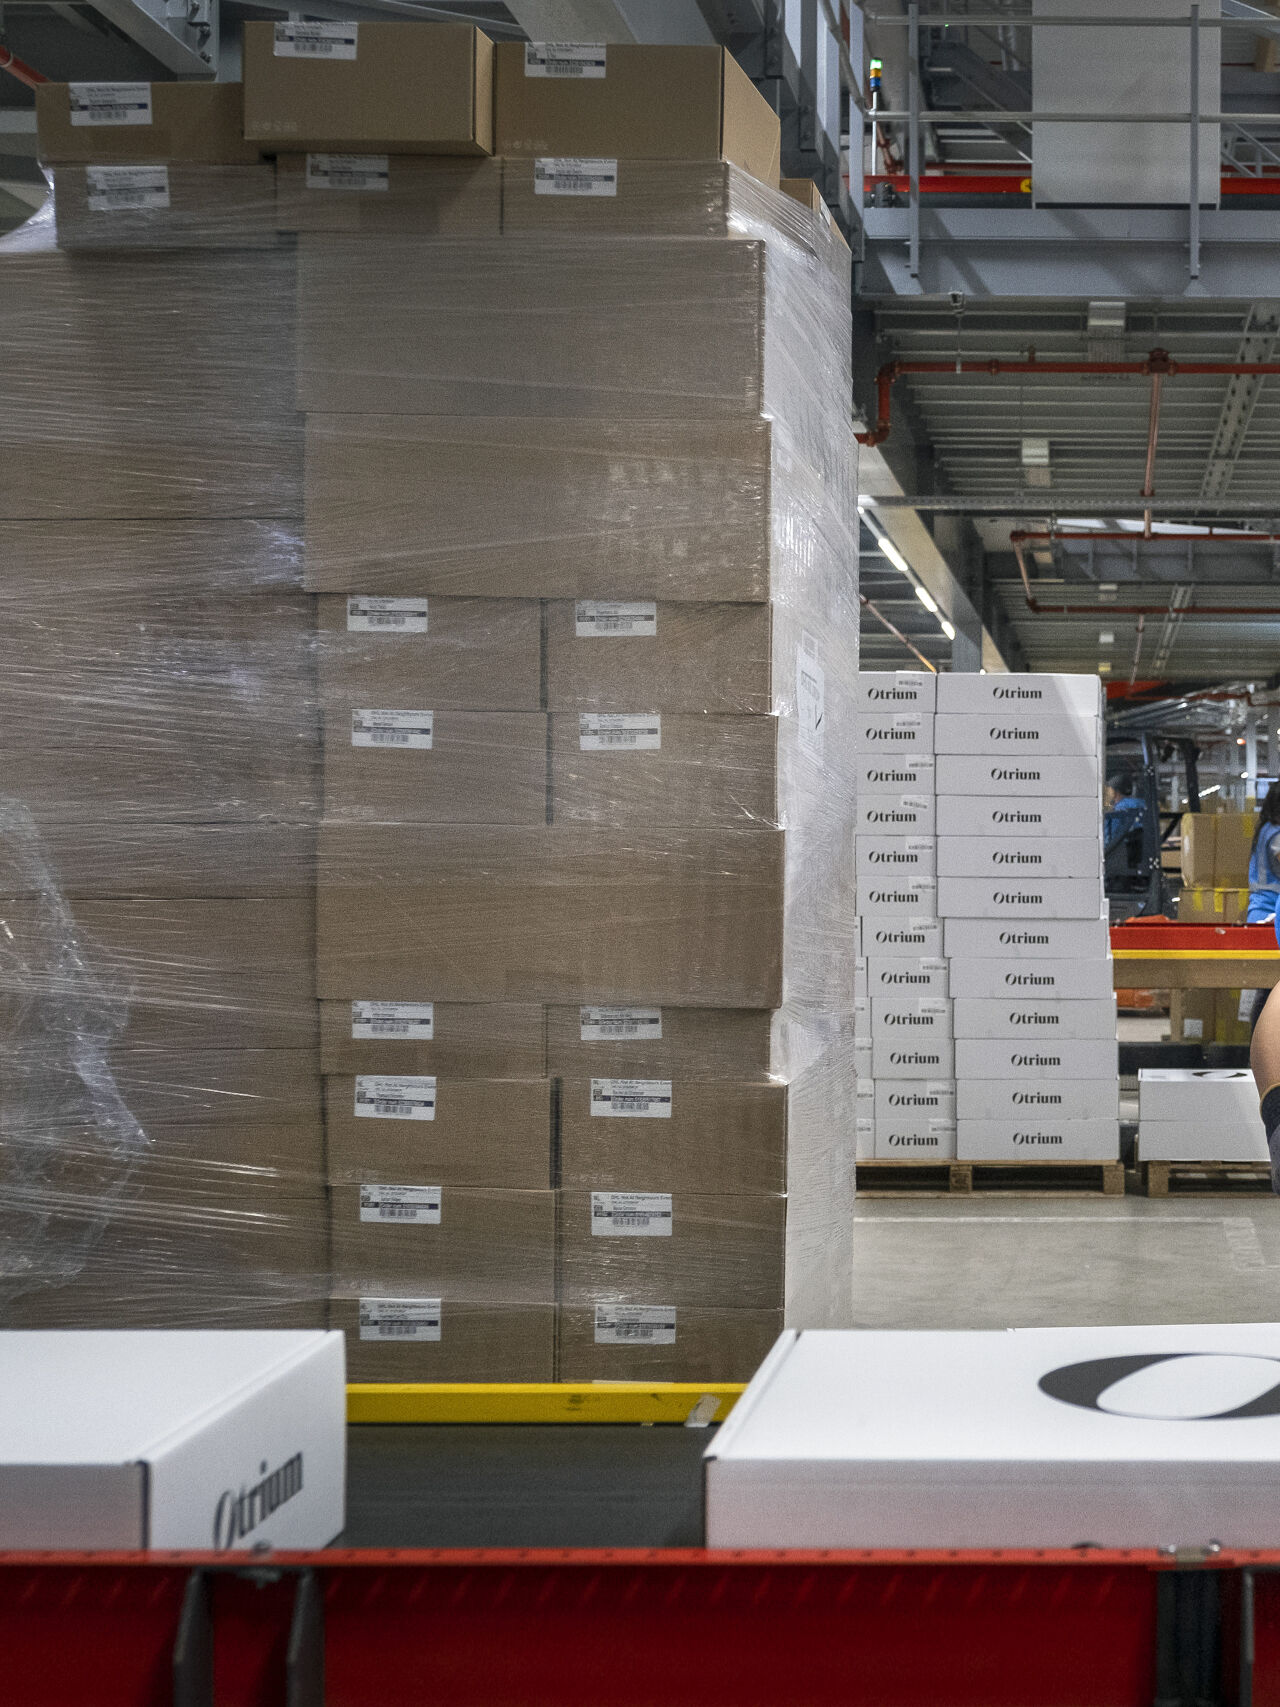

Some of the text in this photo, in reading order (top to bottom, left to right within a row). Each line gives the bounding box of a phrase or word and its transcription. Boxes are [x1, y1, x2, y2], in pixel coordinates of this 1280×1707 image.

[867, 687, 917, 699] Otrium
[992, 686, 1042, 699] Otrium
[865, 727, 915, 740] Otrium
[989, 727, 1039, 739] Otrium
[866, 769, 916, 782] Otrium
[990, 767, 1040, 780] Otrium
[866, 809, 916, 822] Otrium
[991, 810, 1041, 823] Otrium
[868, 850, 918, 863] Otrium
[992, 851, 1042, 864] Otrium
[868, 890, 918, 903] Otrium
[992, 891, 1042, 904] Otrium
[875, 930, 925, 943] Otrium
[998, 931, 1048, 944] Otrium
[880, 971, 930, 984] Otrium
[1004, 972, 1054, 985] Otrium
[883, 1012, 933, 1025] Otrium
[1009, 1011, 1059, 1024] Otrium
[889, 1051, 939, 1064] Otrium
[1010, 1053, 1060, 1066] Otrium
[888, 1093, 938, 1106] Otrium
[1011, 1091, 1061, 1104] Otrium
[888, 1133, 938, 1146] Otrium
[1012, 1132, 1062, 1145] Otrium
[211, 1450, 304, 1551] Otrium
